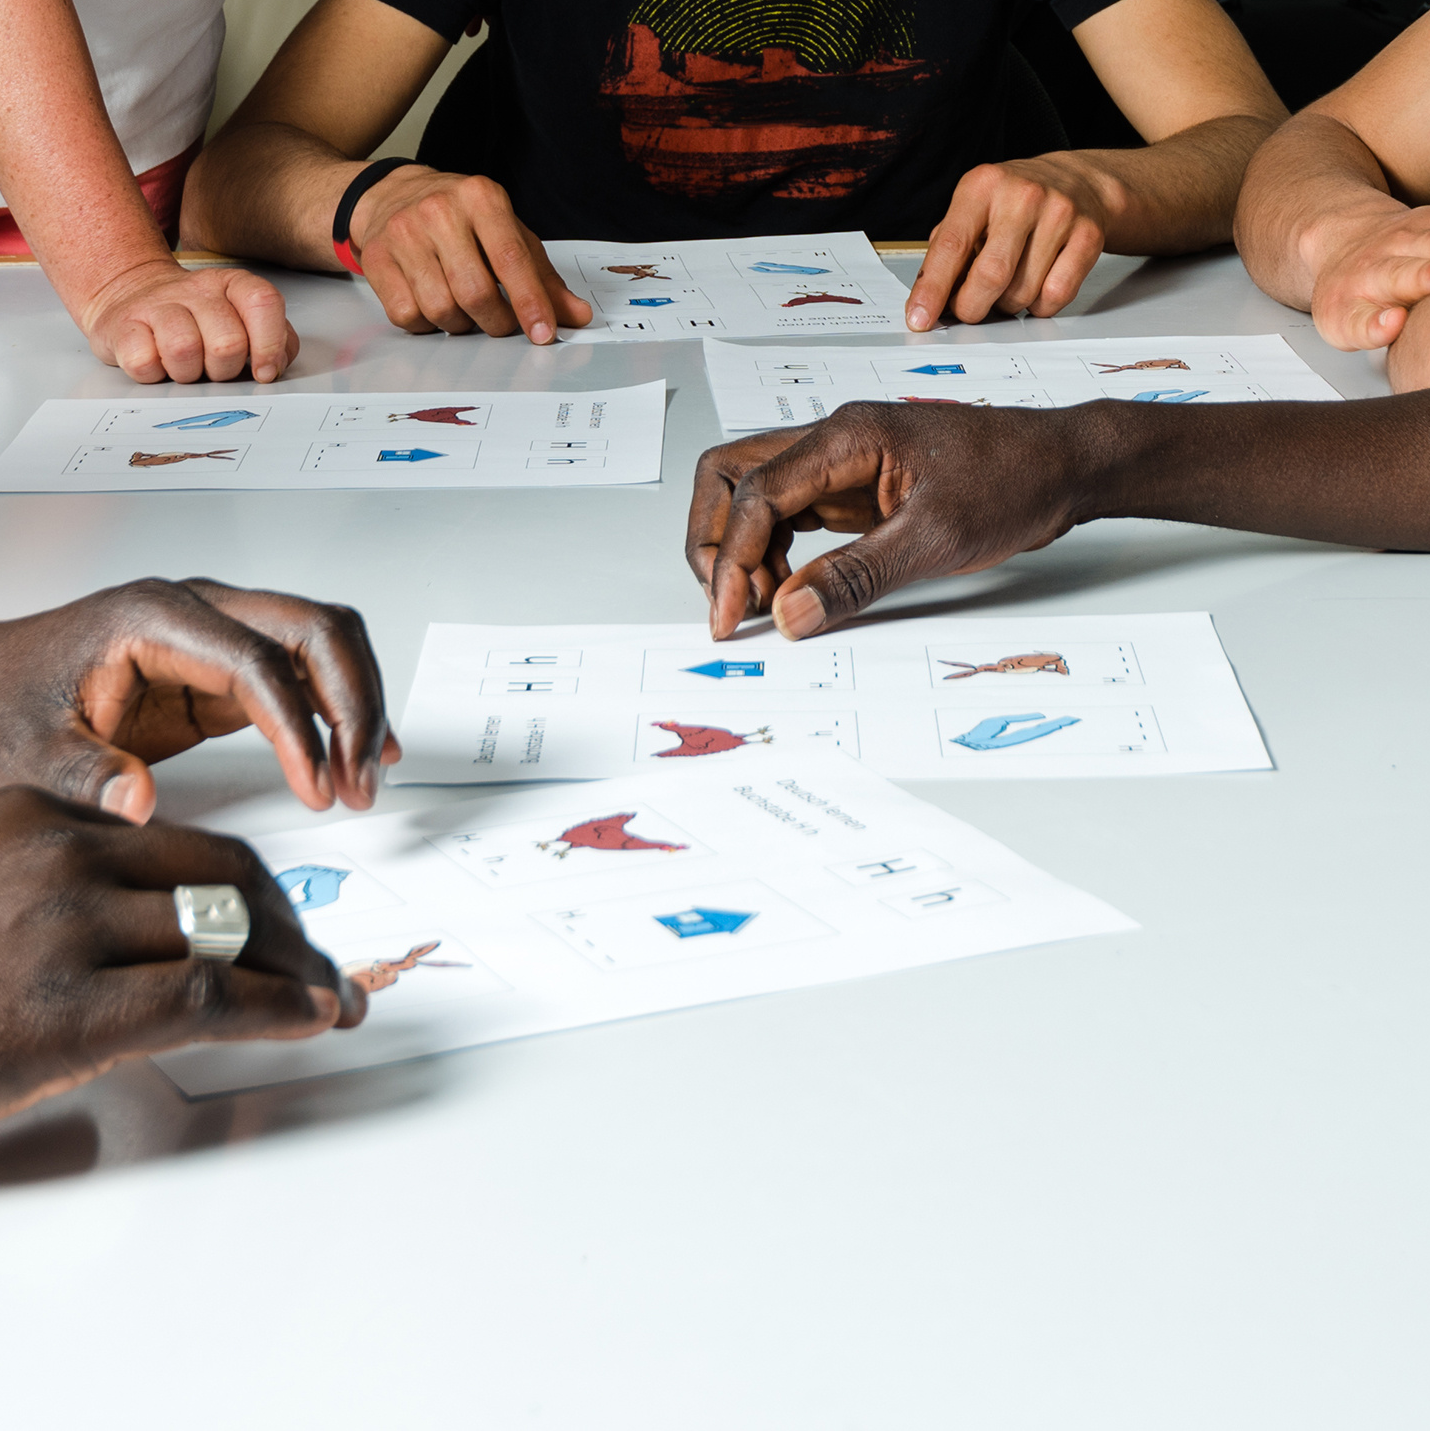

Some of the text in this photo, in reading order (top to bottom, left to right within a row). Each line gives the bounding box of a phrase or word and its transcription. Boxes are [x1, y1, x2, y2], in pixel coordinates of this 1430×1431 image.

[509, 655, 558, 665] h
[507, 681, 554, 692] H
[473, 715, 502, 764] Deutsch lernen
[520, 730, 545, 764] Buchstabe
[733, 785, 797, 822] Buchstabe
[776, 779, 867, 830] Deutsch lernen
[857, 858, 917, 878] H
[911, 887, 961, 907] h
